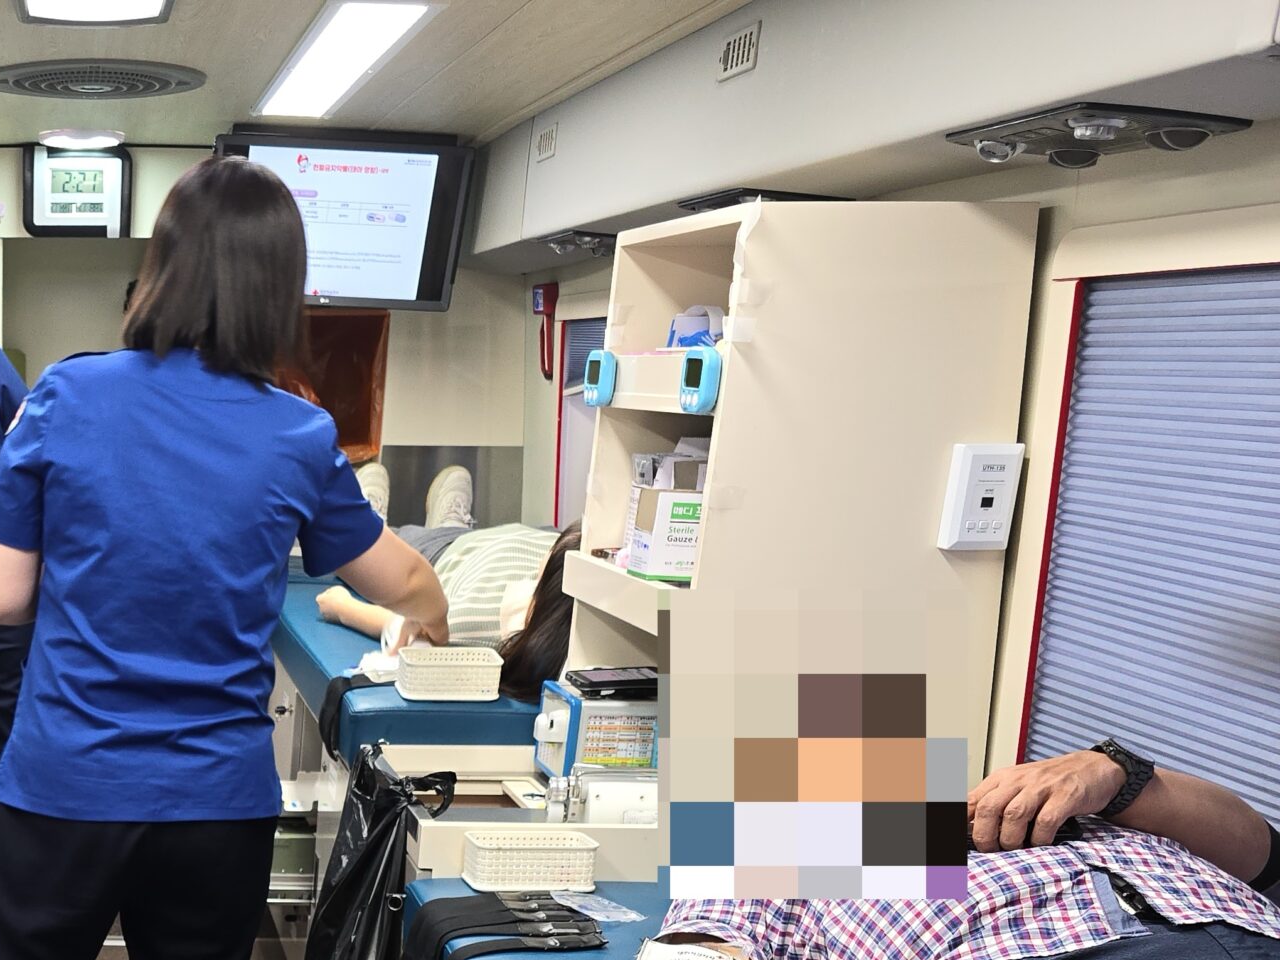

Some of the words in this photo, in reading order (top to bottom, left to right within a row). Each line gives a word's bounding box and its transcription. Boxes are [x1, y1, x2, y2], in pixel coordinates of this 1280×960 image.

[62, 172, 97, 193] 2:21
[668, 526, 695, 534] Sterile
[667, 535, 693, 543] Gauze
